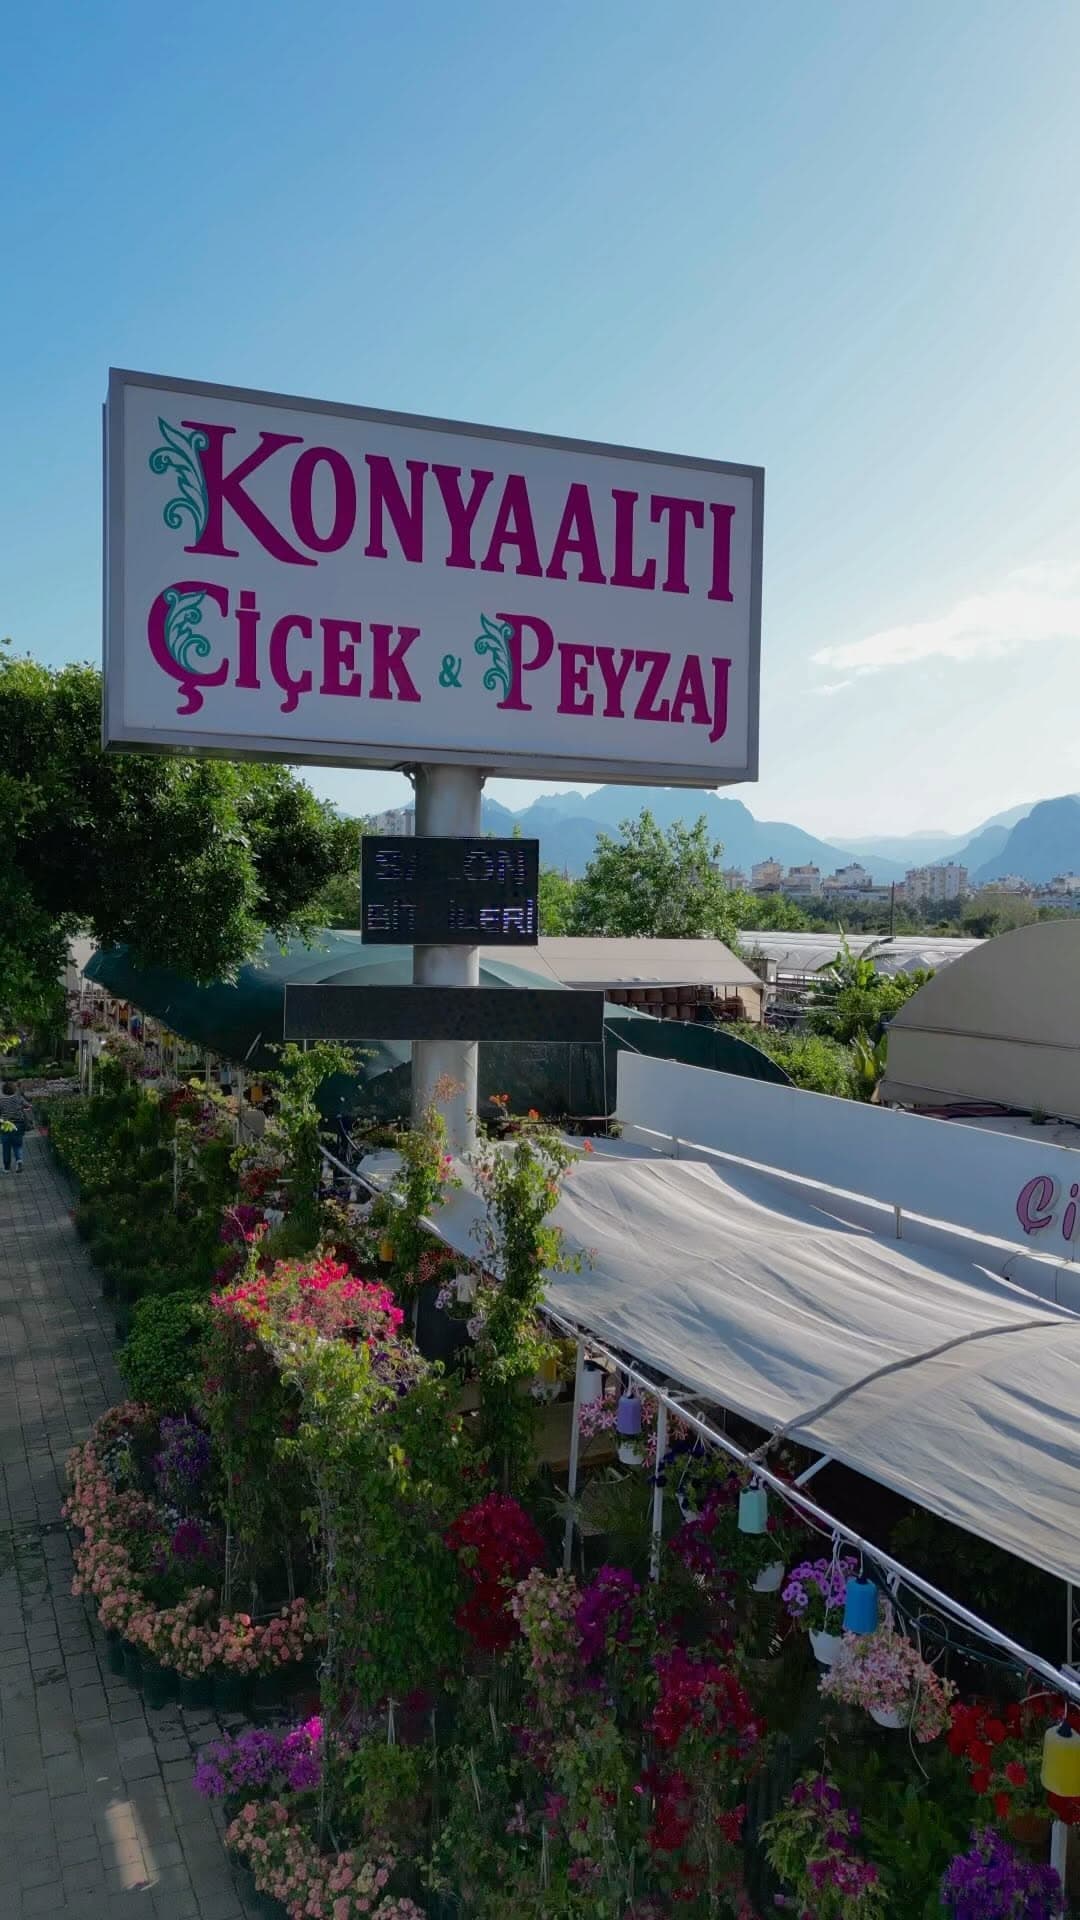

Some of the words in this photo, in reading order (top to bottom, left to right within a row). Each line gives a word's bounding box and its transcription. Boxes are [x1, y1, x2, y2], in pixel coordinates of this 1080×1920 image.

[181, 420, 736, 602] KONYAALTI
[147, 580, 422, 715] ÇİÇEK
[438, 654, 462, 689] &
[497, 612, 732, 744] PEYZAJ
